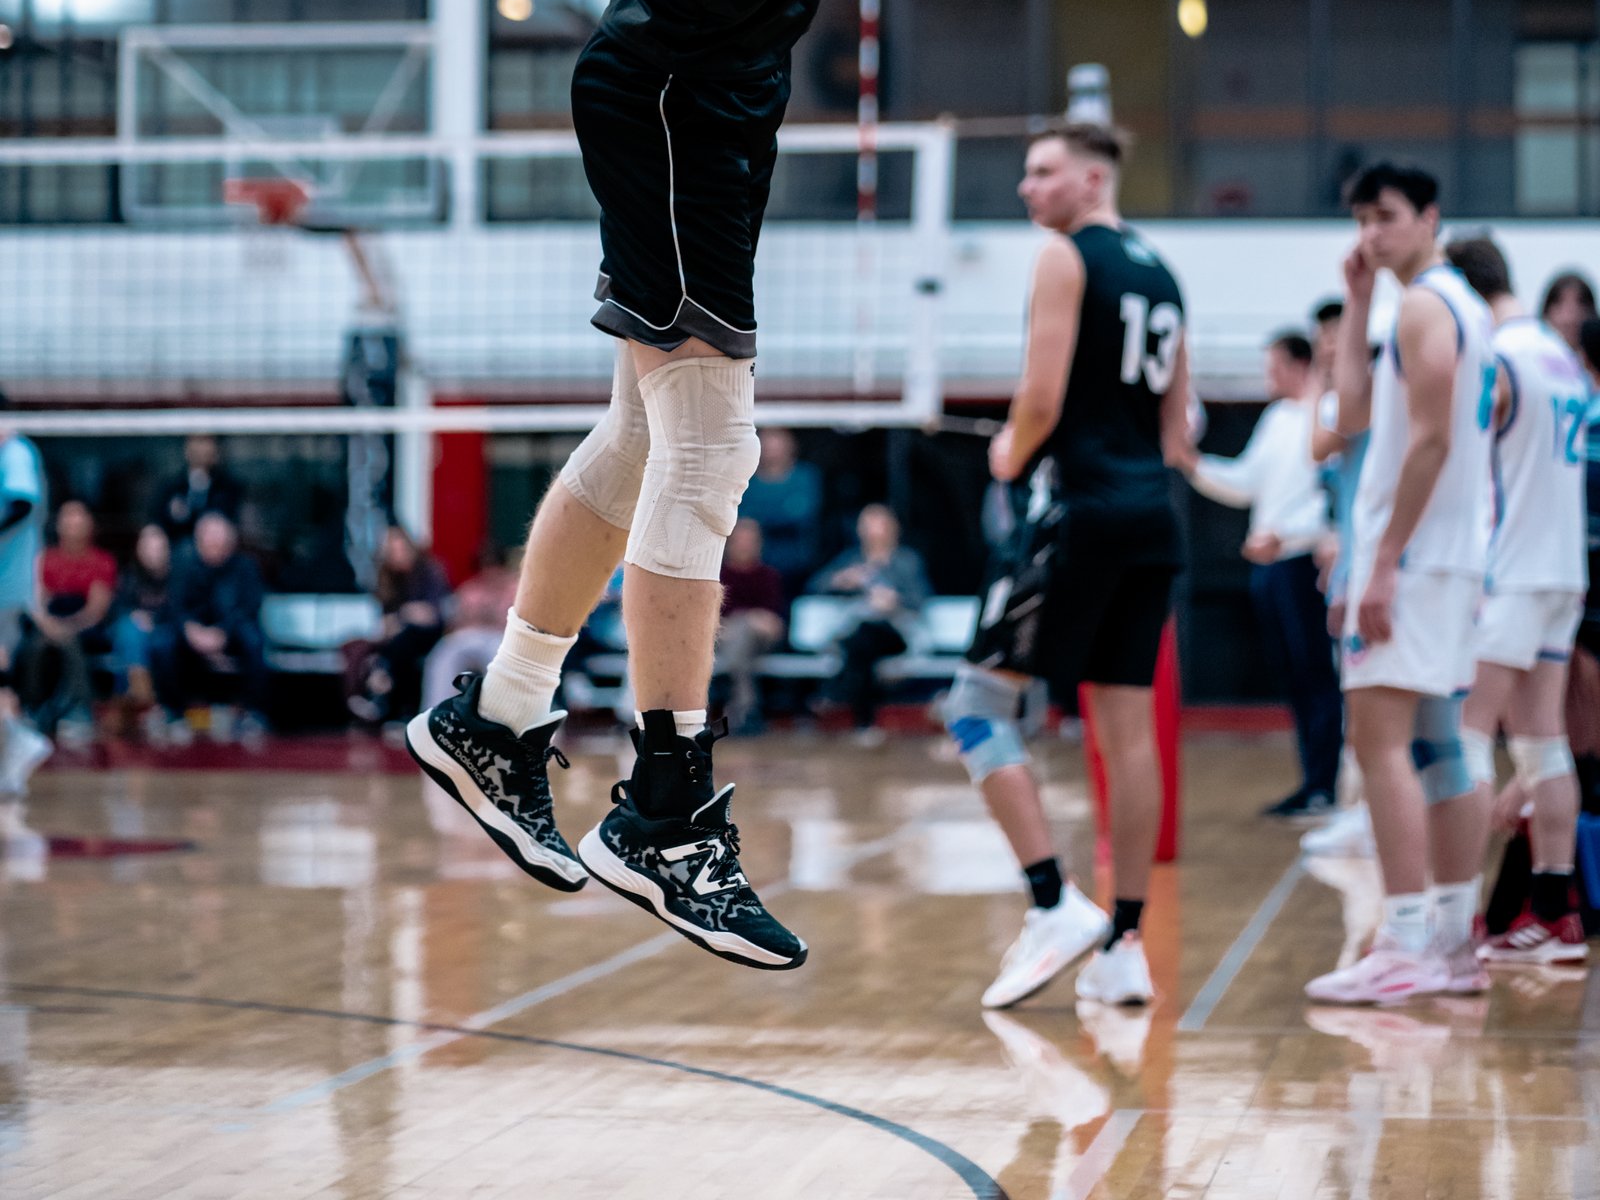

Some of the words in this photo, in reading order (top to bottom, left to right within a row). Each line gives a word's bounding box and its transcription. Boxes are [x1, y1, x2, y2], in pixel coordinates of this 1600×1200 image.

[1119, 292, 1183, 394] 13
[437, 733, 456, 751] new
[454, 748, 485, 785] balance
